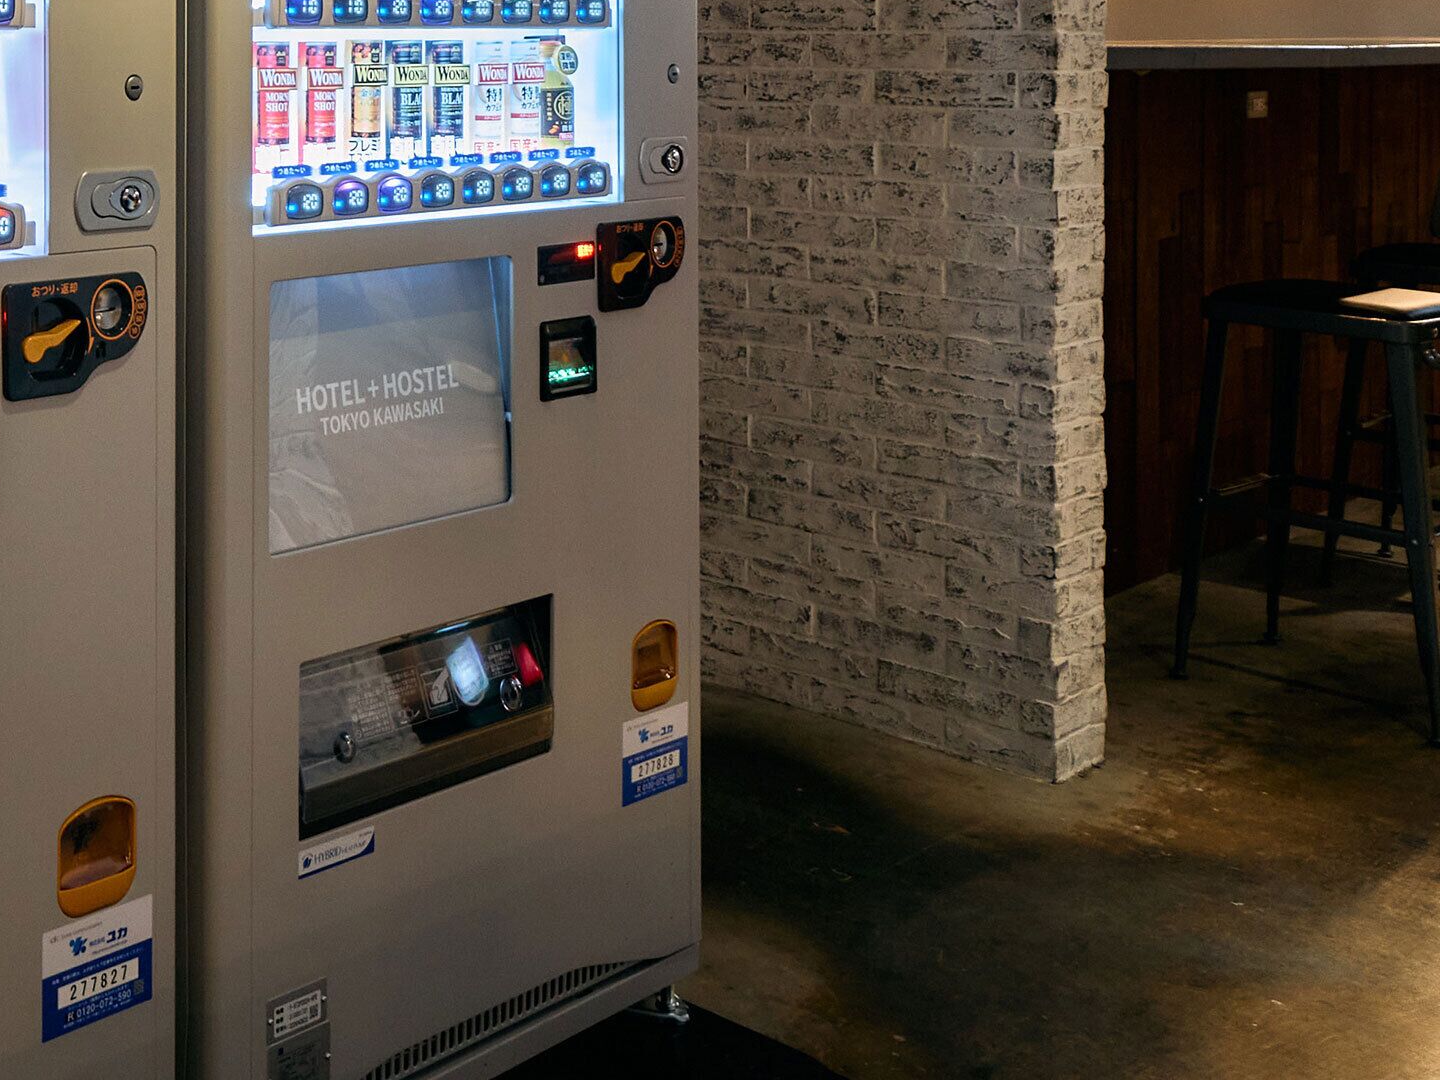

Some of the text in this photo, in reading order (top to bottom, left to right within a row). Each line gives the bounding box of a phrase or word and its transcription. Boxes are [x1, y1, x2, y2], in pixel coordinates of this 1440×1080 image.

[261, 68, 295, 87] WONDA
[310, 68, 343, 87] WONDA
[356, 65, 387, 83] WONDA
[397, 66, 427, 81] WONDA
[437, 66, 469, 81] WONDA
[265, 102, 288, 112] SHOT
[296, 378, 366, 414] HOTEL
[383, 364, 459, 400] HOSTEL
[320, 397, 444, 436] TOKYO KAWASAKI
[638, 753, 674, 777] 277828
[70, 965, 128, 1001] 277827
